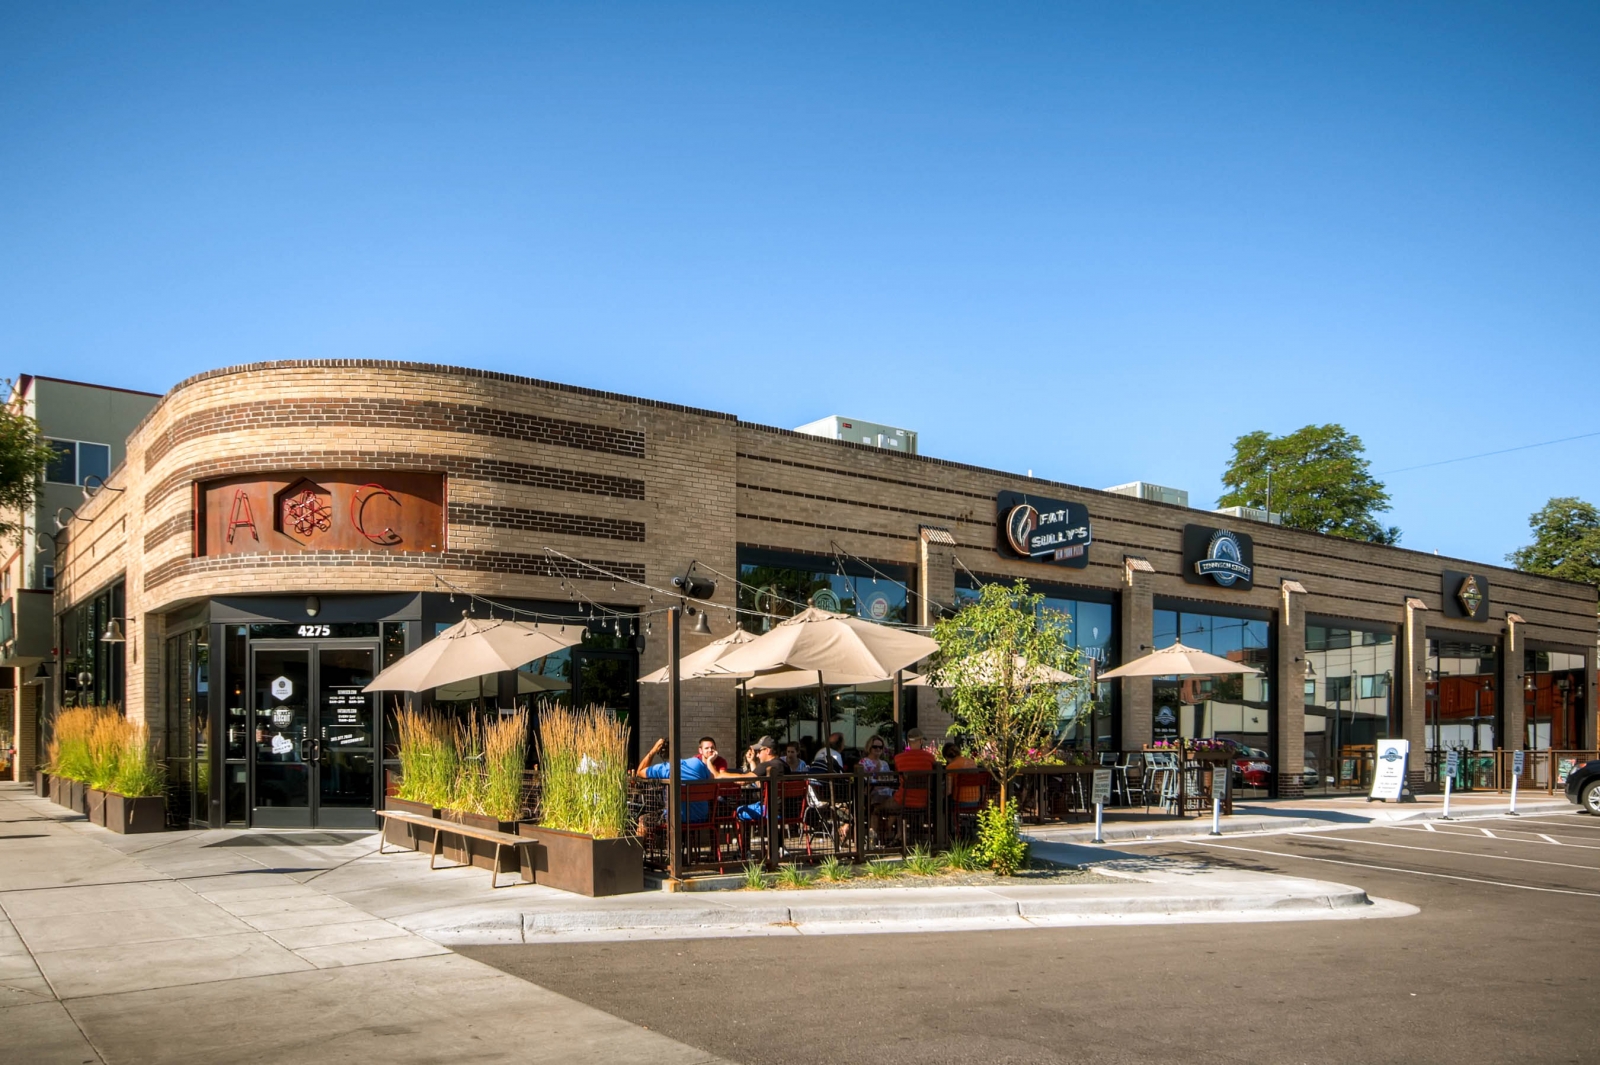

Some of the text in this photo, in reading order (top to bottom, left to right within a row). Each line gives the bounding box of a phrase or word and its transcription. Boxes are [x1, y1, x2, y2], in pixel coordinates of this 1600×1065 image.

[1039, 510, 1066, 525] FAT
[1031, 527, 1088, 548] SULLY'S
[297, 624, 331, 637] 4275
[1085, 646, 1105, 662] PIZZA
